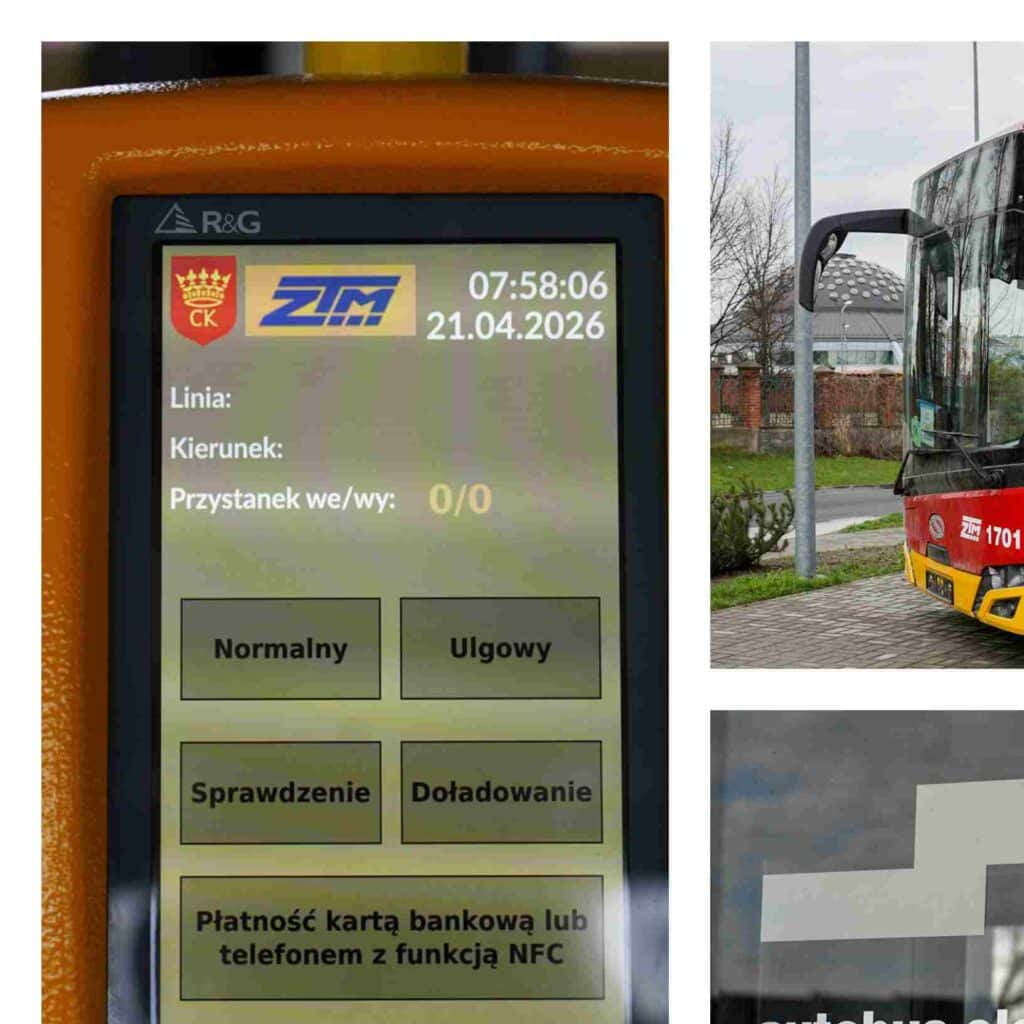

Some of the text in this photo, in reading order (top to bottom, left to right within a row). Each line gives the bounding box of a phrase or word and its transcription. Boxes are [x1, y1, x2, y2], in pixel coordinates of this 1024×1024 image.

[202, 210, 261, 233] R&G
[468, 270, 609, 300] 07:58:06
[259, 275, 402, 326] ZTM
[189, 309, 219, 327] CK
[426, 311, 606, 340] 21.04.2026
[170, 387, 231, 408] Linia:
[170, 436, 283, 459] Kierunek:
[170, 483, 492, 517] Przystanek we/wy: 0/0
[960, 515, 1021, 550] ZTM 1701
[214, 637, 348, 664] Normalny
[450, 637, 552, 664] Ulgowy
[191, 781, 371, 807] Sprawdzenie
[411, 780, 593, 803] Doładowanie
[196, 909, 588, 935] Płatność kartą bankową lub
[219, 943, 565, 969] telefonem z funkcją NFC
